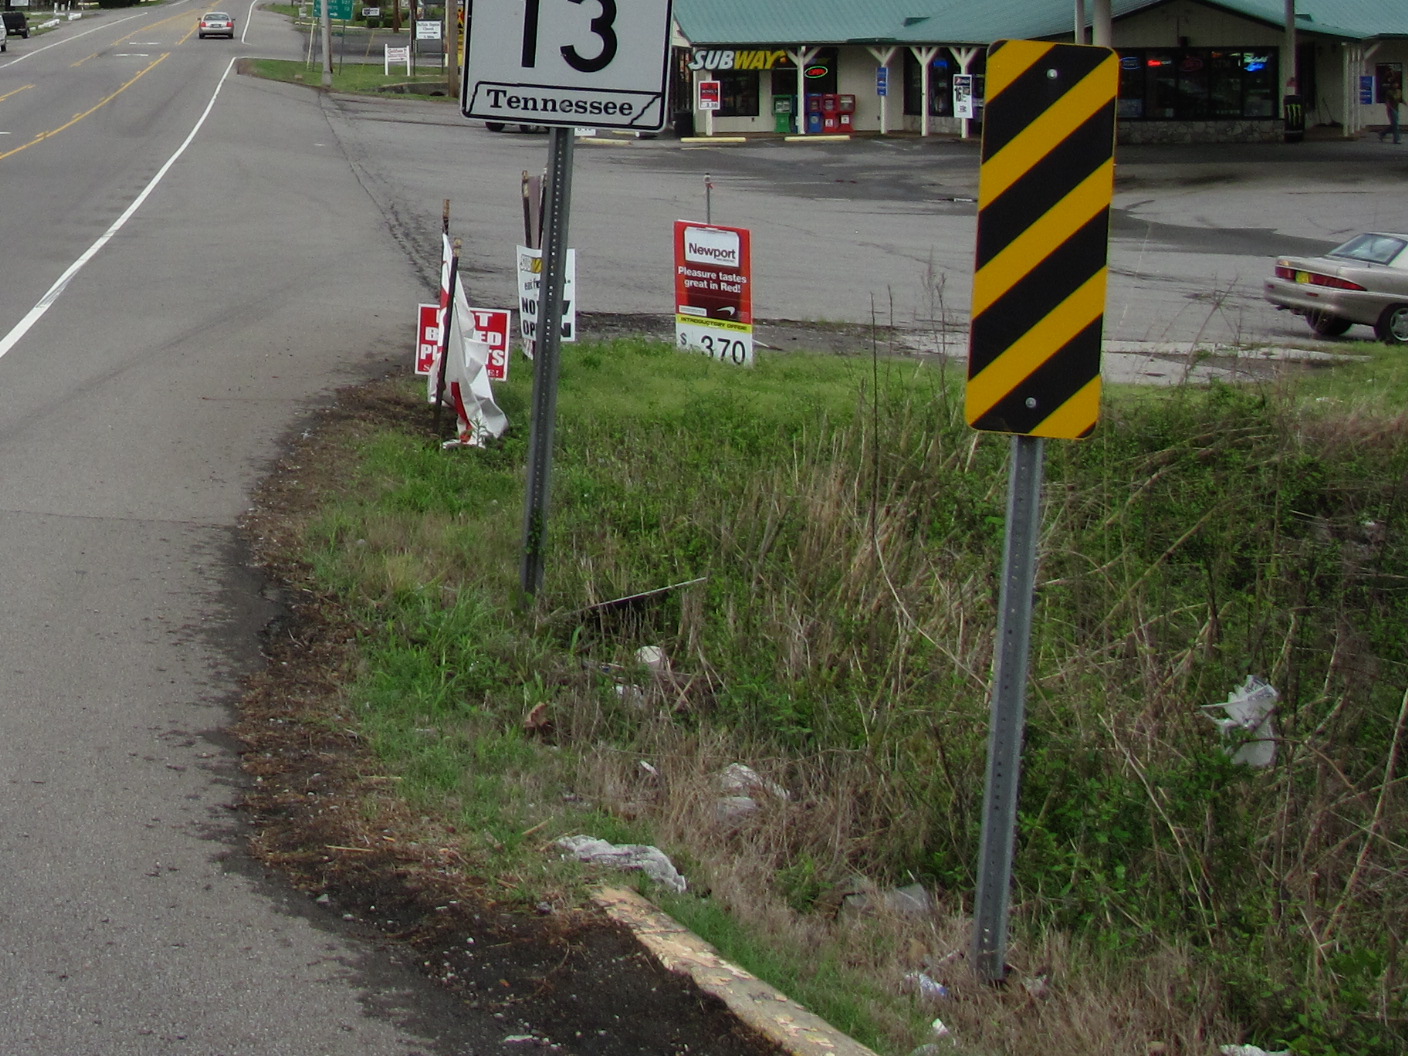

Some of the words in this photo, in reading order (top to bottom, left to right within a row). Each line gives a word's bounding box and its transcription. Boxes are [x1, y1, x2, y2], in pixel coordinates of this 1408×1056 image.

[688, 50, 787, 71] SUBWAY
[486, 88, 633, 116] Tennessee
[688, 243, 736, 260] Newport
[678, 266, 717, 280] Pleasure
[719, 272, 747, 284] tastes
[684, 278, 708, 290] great
[709, 280, 719, 290] in
[720, 282, 741, 293] Red!
